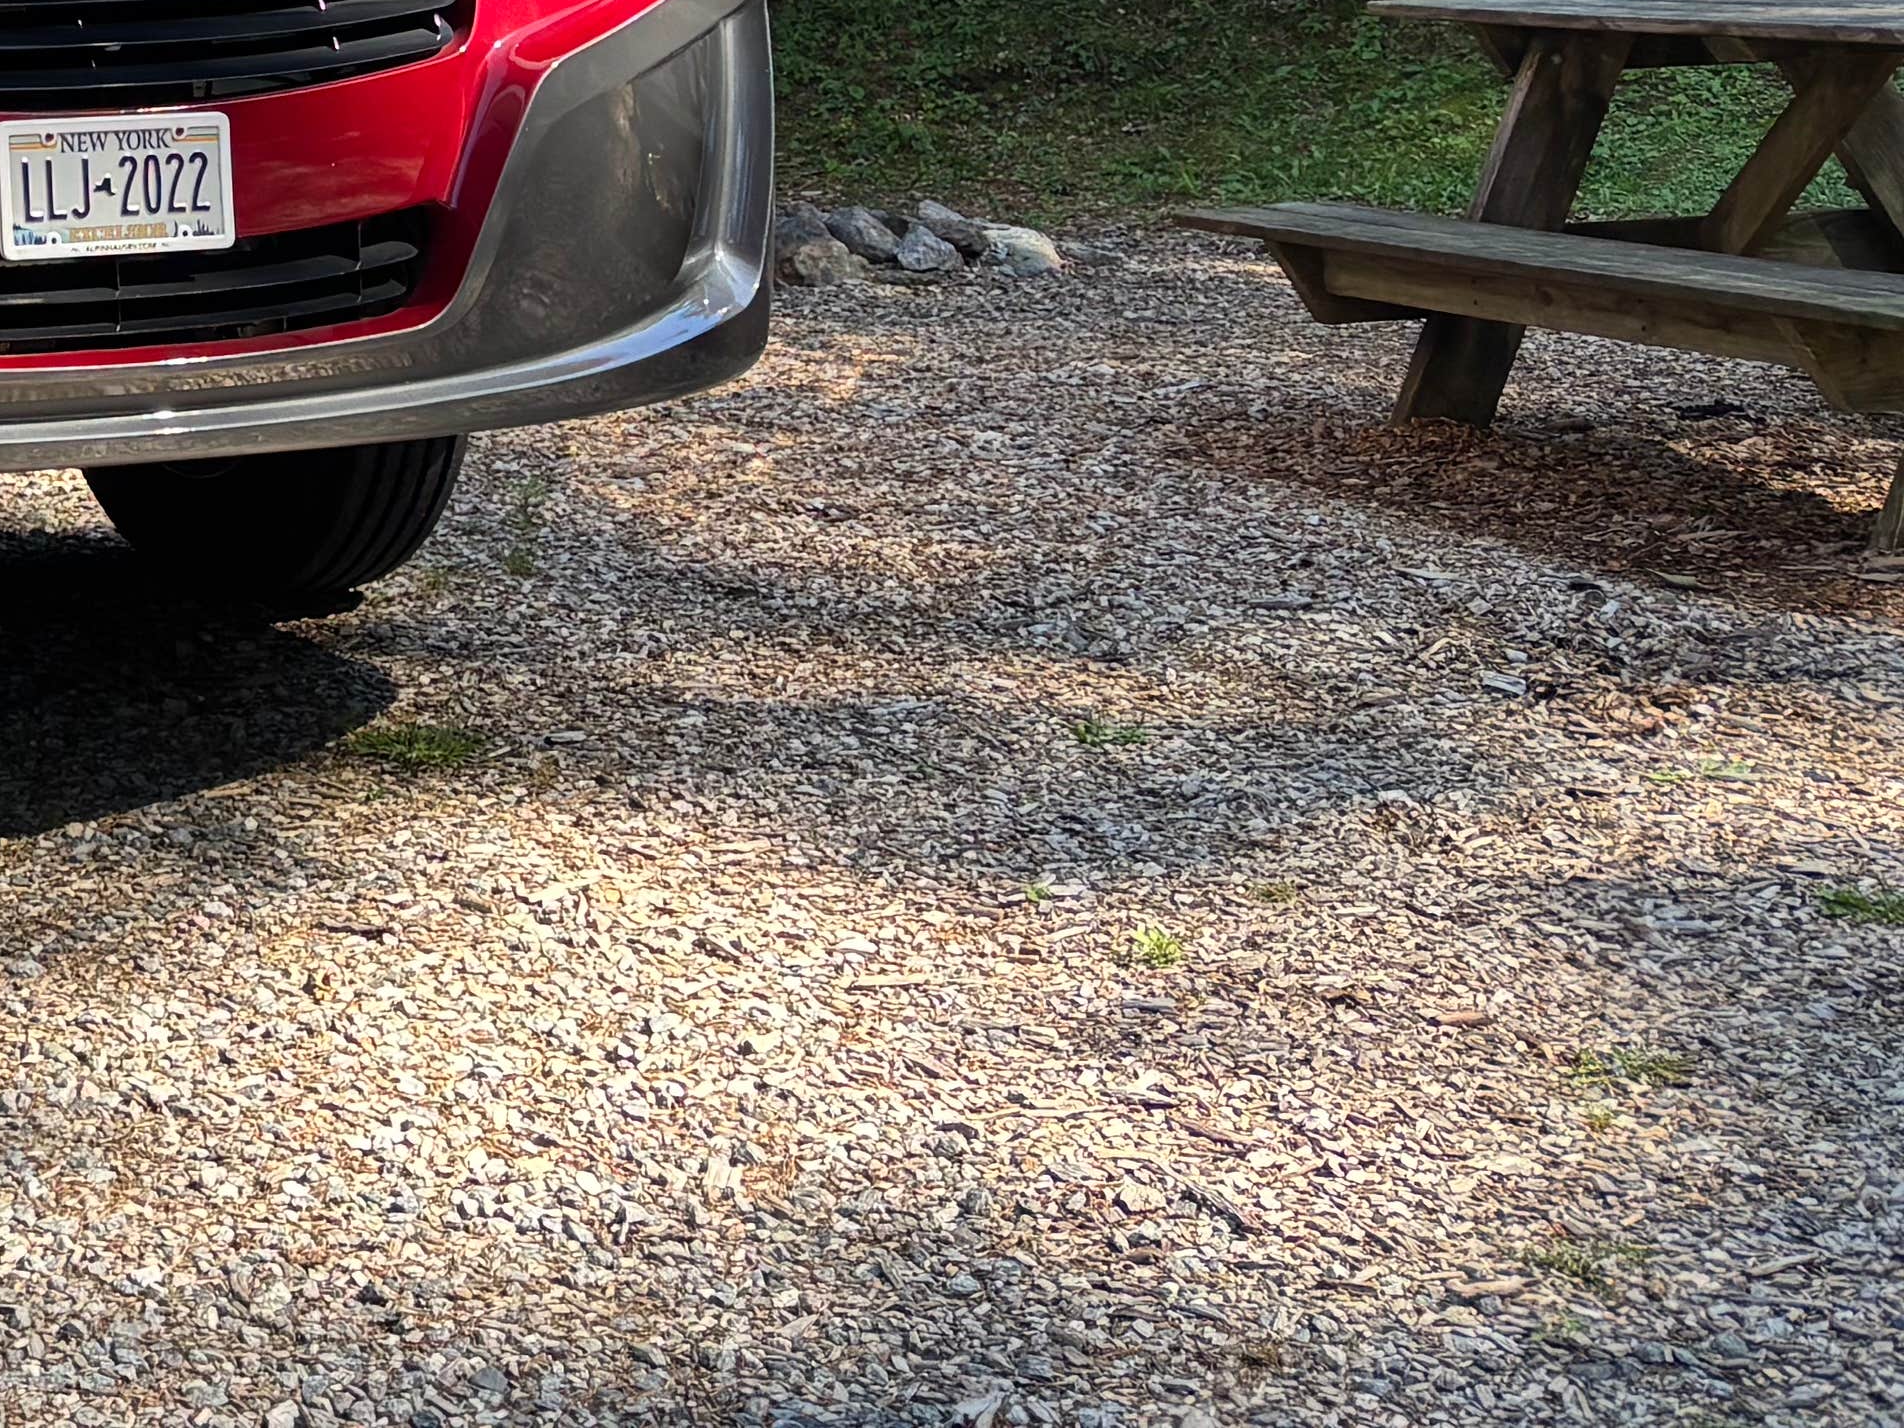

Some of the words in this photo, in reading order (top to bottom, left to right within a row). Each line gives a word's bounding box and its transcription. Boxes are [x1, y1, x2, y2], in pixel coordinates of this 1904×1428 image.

[59, 131, 113, 153] NEW
[114, 127, 172, 151] YORK
[20, 156, 91, 223] LLJ
[118, 151, 211, 217] 2022
